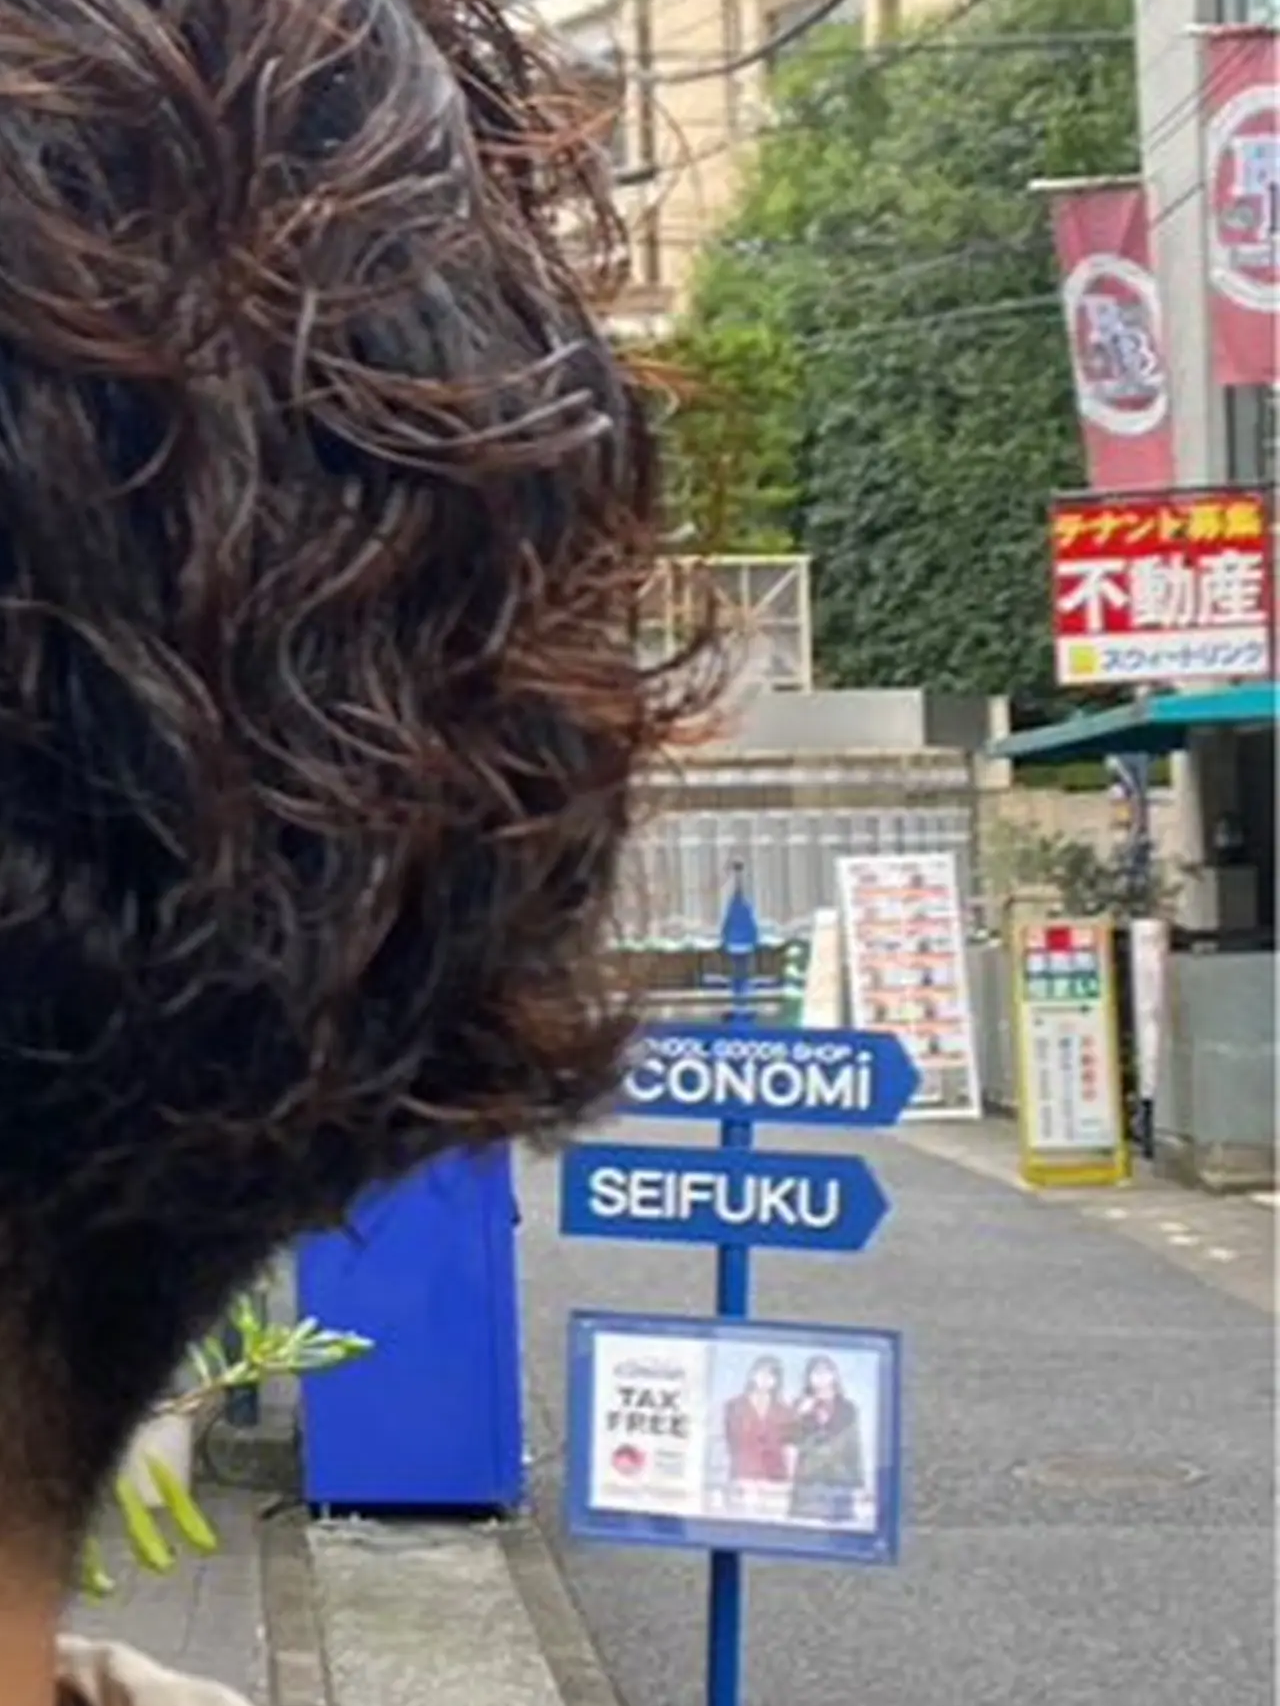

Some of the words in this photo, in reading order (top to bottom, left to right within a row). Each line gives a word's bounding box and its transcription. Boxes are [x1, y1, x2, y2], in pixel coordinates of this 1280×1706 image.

[1056, 549, 1267, 635] 不動産
[625, 1050, 872, 1110] CONOMi
[590, 1166, 839, 1227] SEIFUKU
[606, 1409, 689, 1439] FREE
[618, 1386, 681, 1411] TAX
